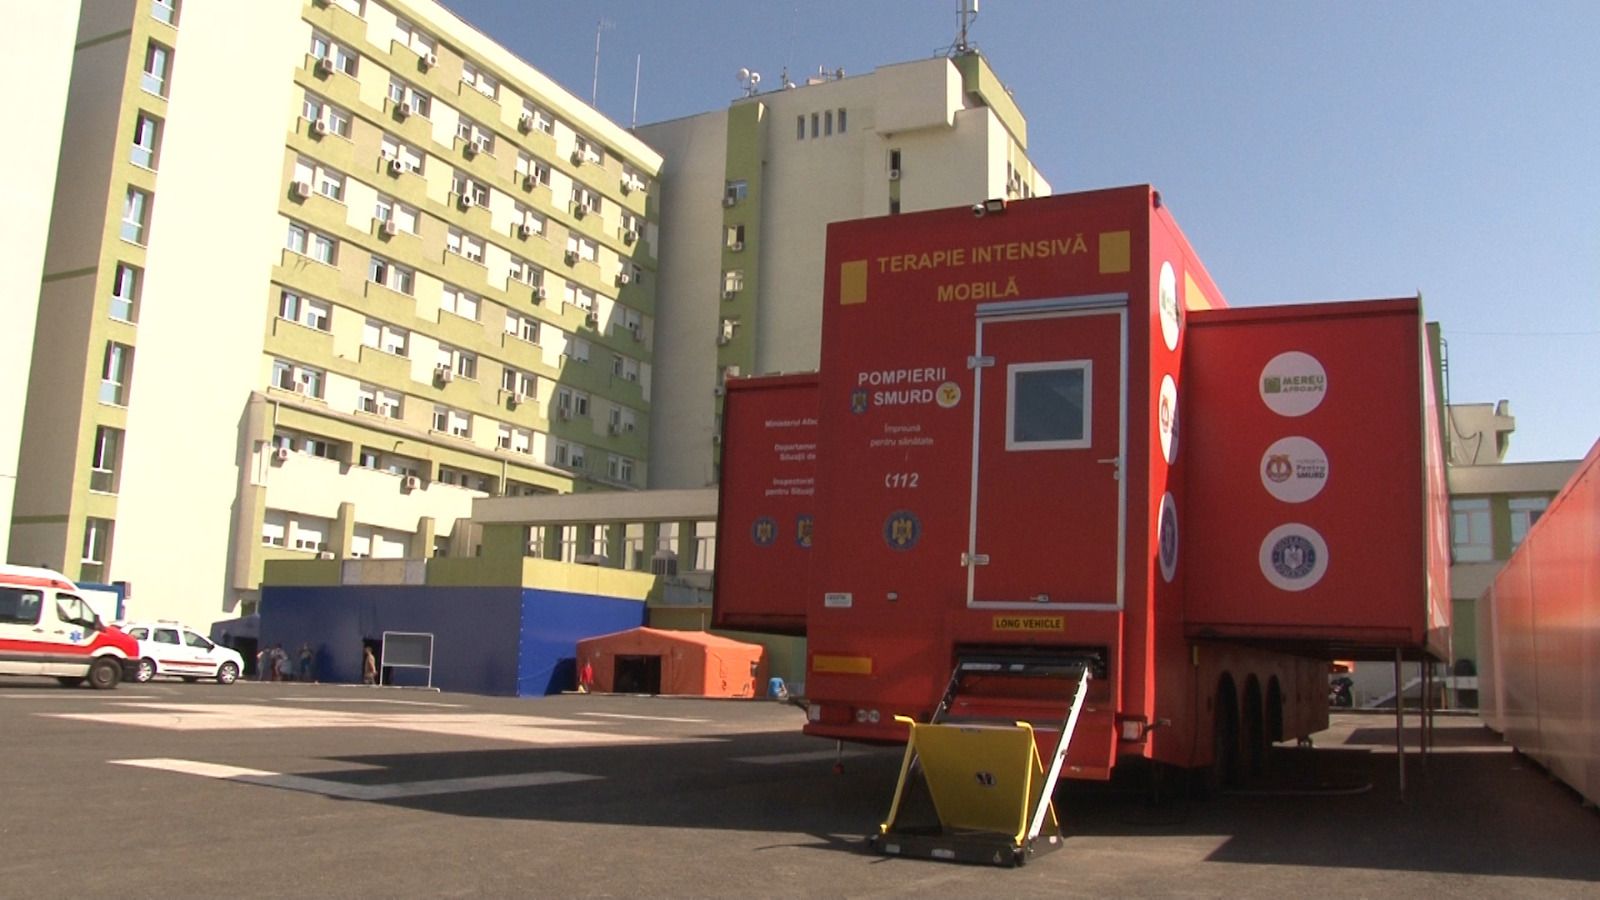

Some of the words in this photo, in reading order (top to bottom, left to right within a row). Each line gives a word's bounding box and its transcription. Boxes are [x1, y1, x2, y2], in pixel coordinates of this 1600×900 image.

[877, 249, 966, 273] TERAPIE
[972, 234, 1087, 263] INTENSIVĂ
[937, 276, 1019, 302] MOBILĂ
[858, 367, 947, 386] POMPIERII
[1282, 375, 1324, 385] MEREU
[873, 389, 934, 406] SMURD
[1296, 471, 1326, 479] SMURD
[996, 619, 1021, 629] LONG
[1022, 619, 1061, 629] VEHICLE
